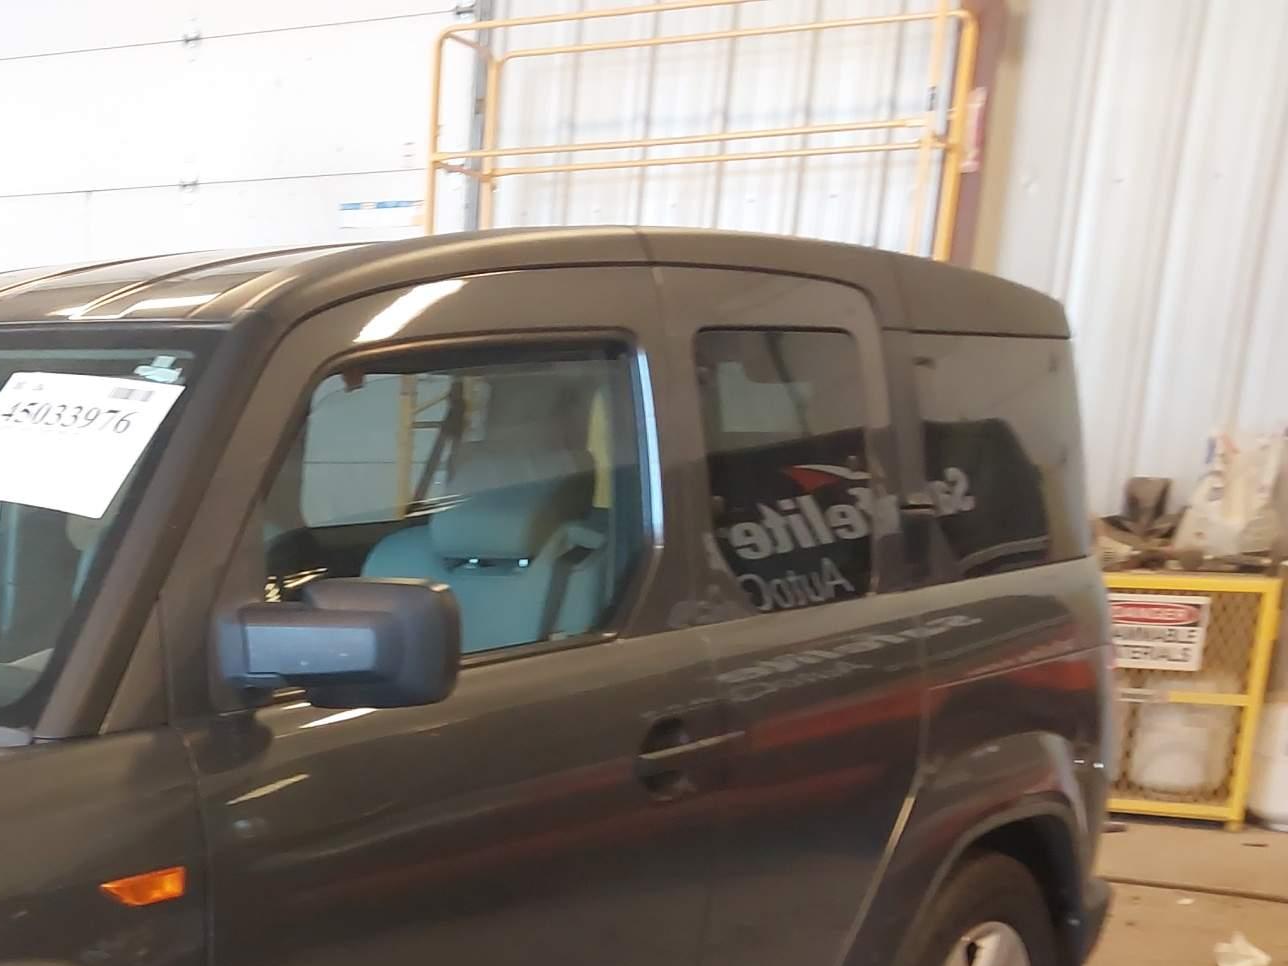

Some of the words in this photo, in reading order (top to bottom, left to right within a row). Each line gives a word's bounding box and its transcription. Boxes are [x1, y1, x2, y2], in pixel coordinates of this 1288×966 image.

[0, 401, 137, 434] 45033976
[1112, 628, 1197, 645] AMMABLE
[1116, 644, 1191, 663] TERIALS
